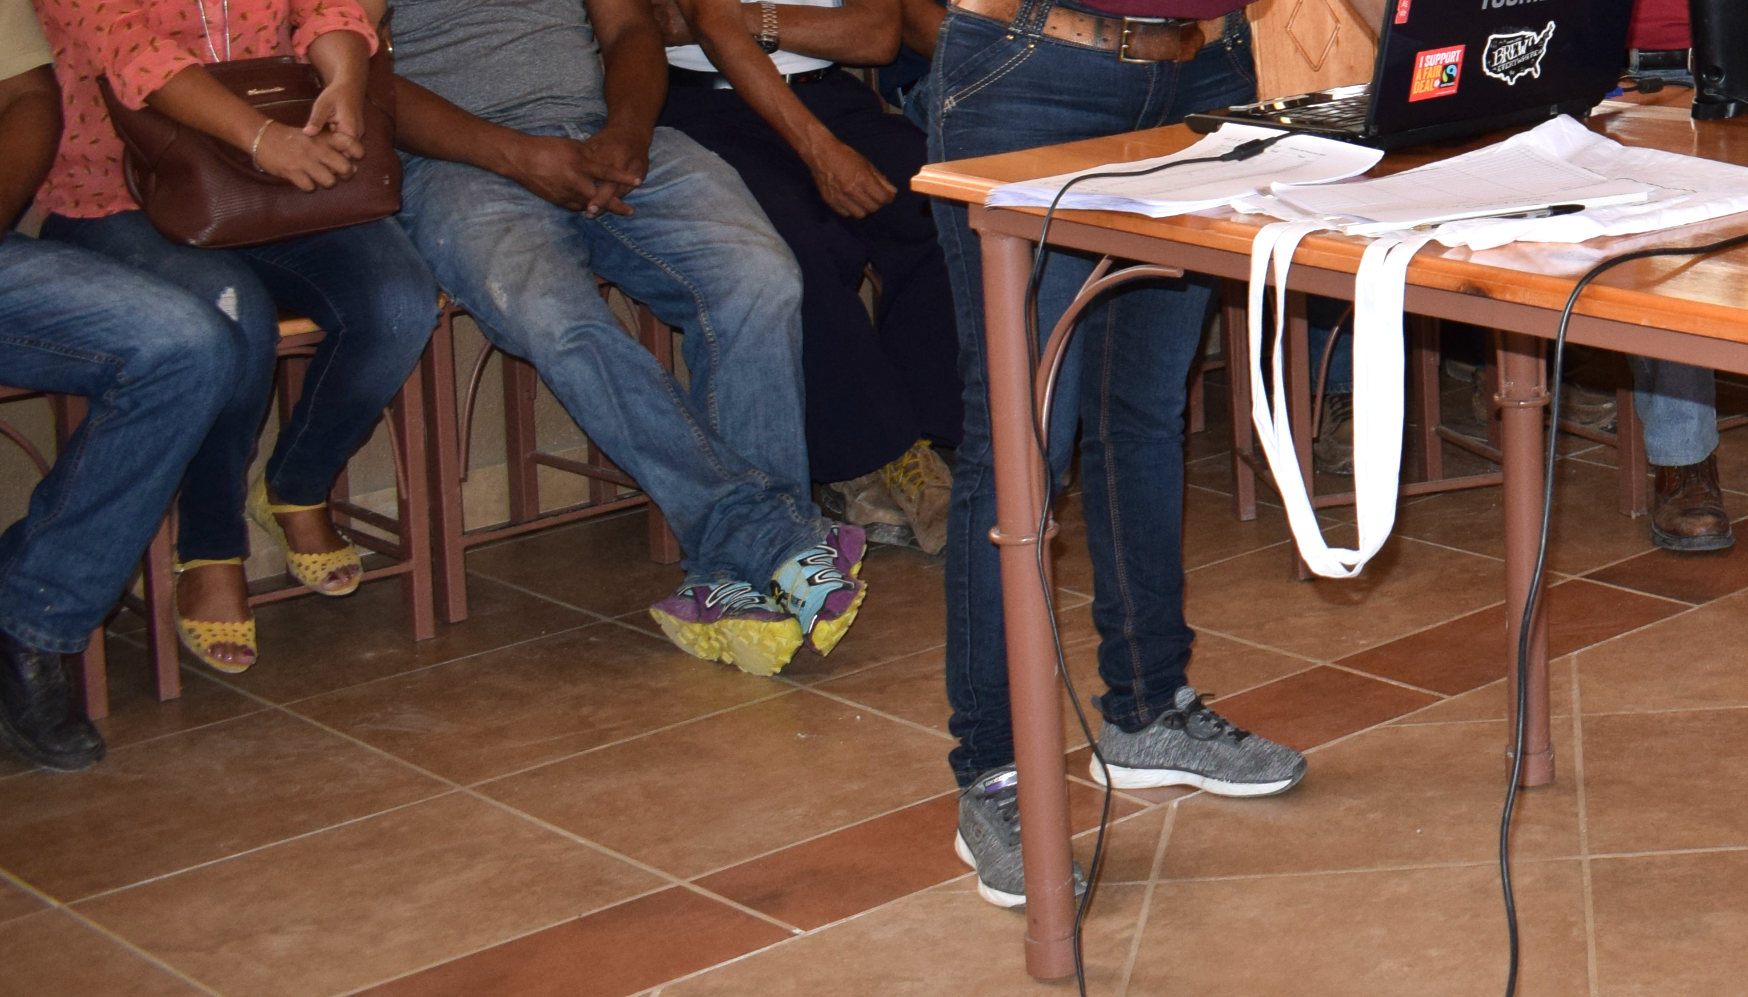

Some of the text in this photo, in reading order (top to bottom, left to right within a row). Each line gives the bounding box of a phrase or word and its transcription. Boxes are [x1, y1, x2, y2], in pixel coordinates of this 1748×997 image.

[1419, 50, 1462, 68] I SUPPORT
[1492, 38, 1530, 67] BREW
[1416, 65, 1442, 80] A FAIR
[1413, 79, 1434, 94] DEAL
